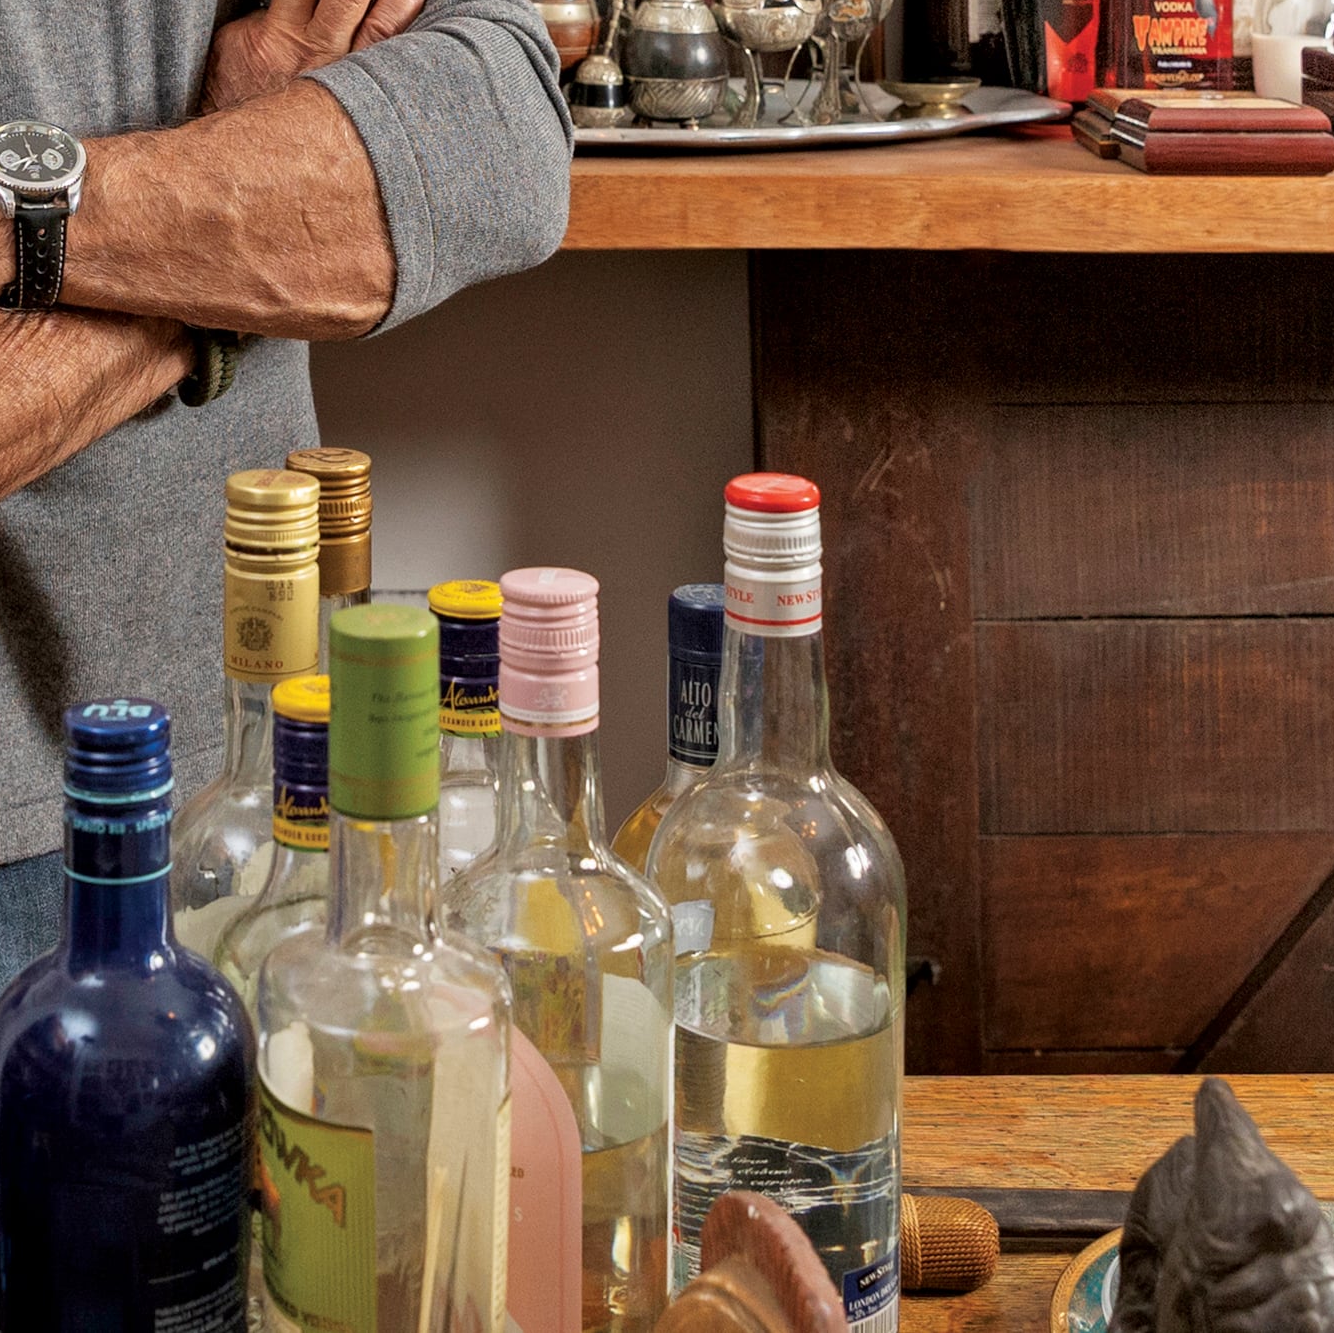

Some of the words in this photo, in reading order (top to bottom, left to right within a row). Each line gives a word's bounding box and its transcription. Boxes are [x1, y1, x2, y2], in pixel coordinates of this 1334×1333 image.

[1154, 1, 1194, 13] VODKA
[1133, 15, 1209, 52] VAMPIRE
[776, 593, 805, 607] NEW
[230, 654, 284, 669] MILANO
[680, 679, 712, 708] ALTO
[440, 714, 476, 728] LEXANDER
[684, 706, 707, 721] del
